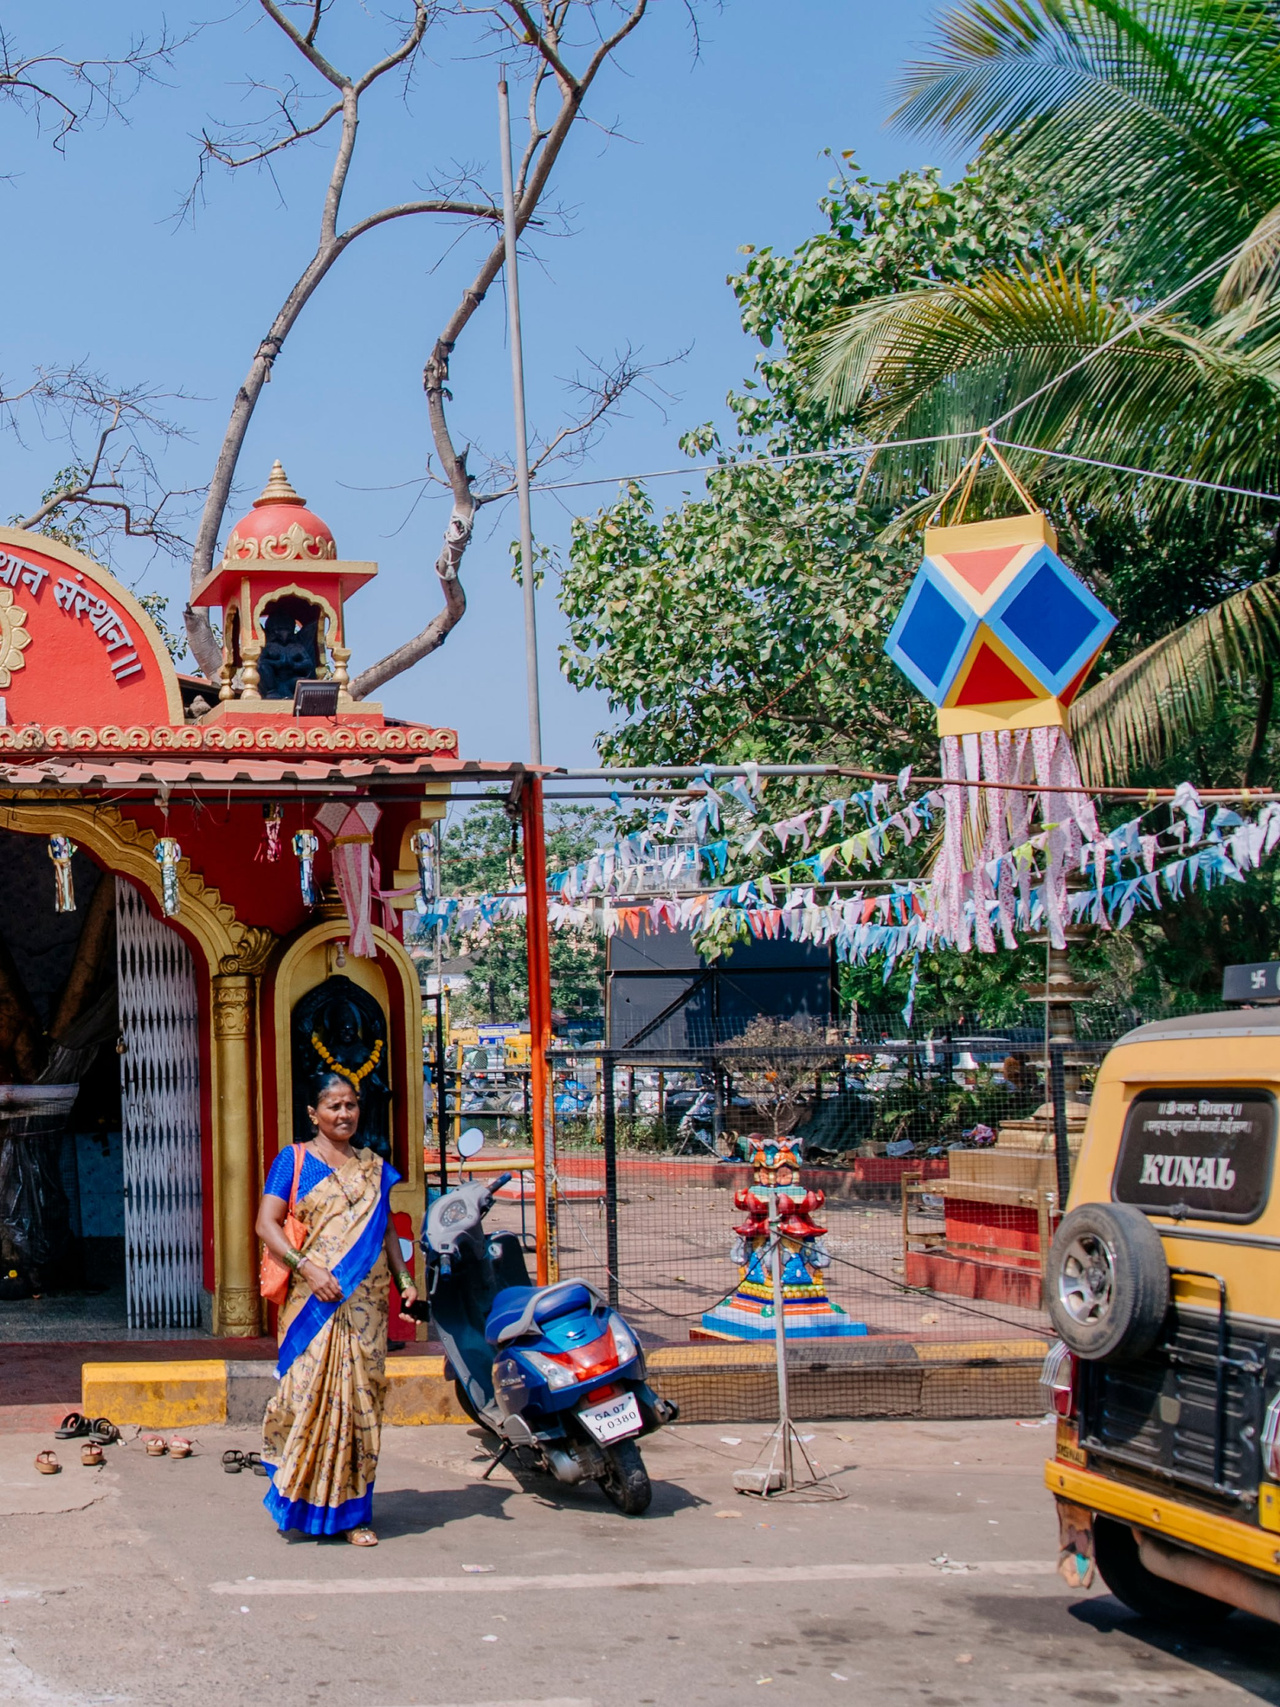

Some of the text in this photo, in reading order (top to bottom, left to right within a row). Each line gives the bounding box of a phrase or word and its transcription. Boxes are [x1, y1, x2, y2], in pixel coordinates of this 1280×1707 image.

[53, 573, 134, 653] संस्थान
[1139, 1154, 1236, 1190] KUNAL
[595, 1403, 625, 1421] GA 07
[607, 1411, 636, 1429] 0380
